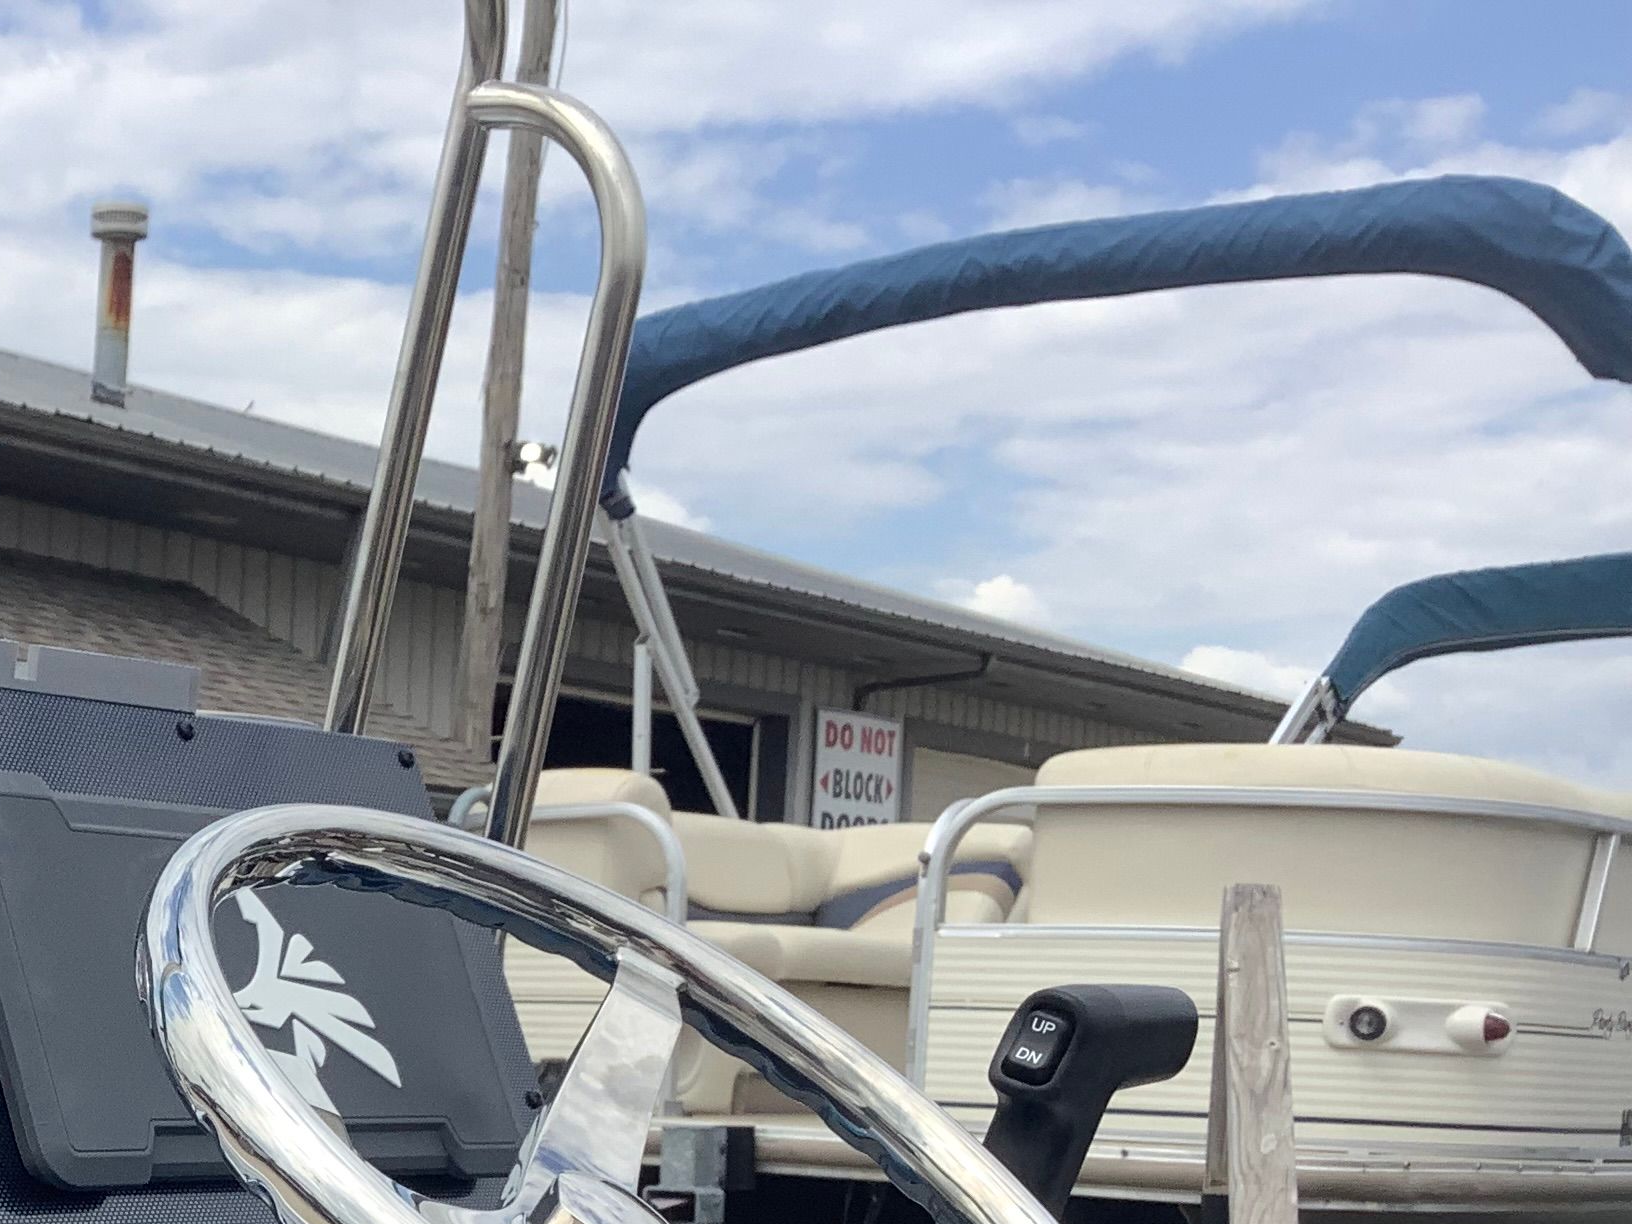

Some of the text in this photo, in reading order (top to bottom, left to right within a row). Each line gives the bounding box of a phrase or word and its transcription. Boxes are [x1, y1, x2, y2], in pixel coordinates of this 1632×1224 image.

[825, 720, 896, 757] DO NOT
[832, 768, 884, 804] BLOCK
[1031, 1017, 1056, 1035] UP
[1015, 1047, 1042, 1065] DN
